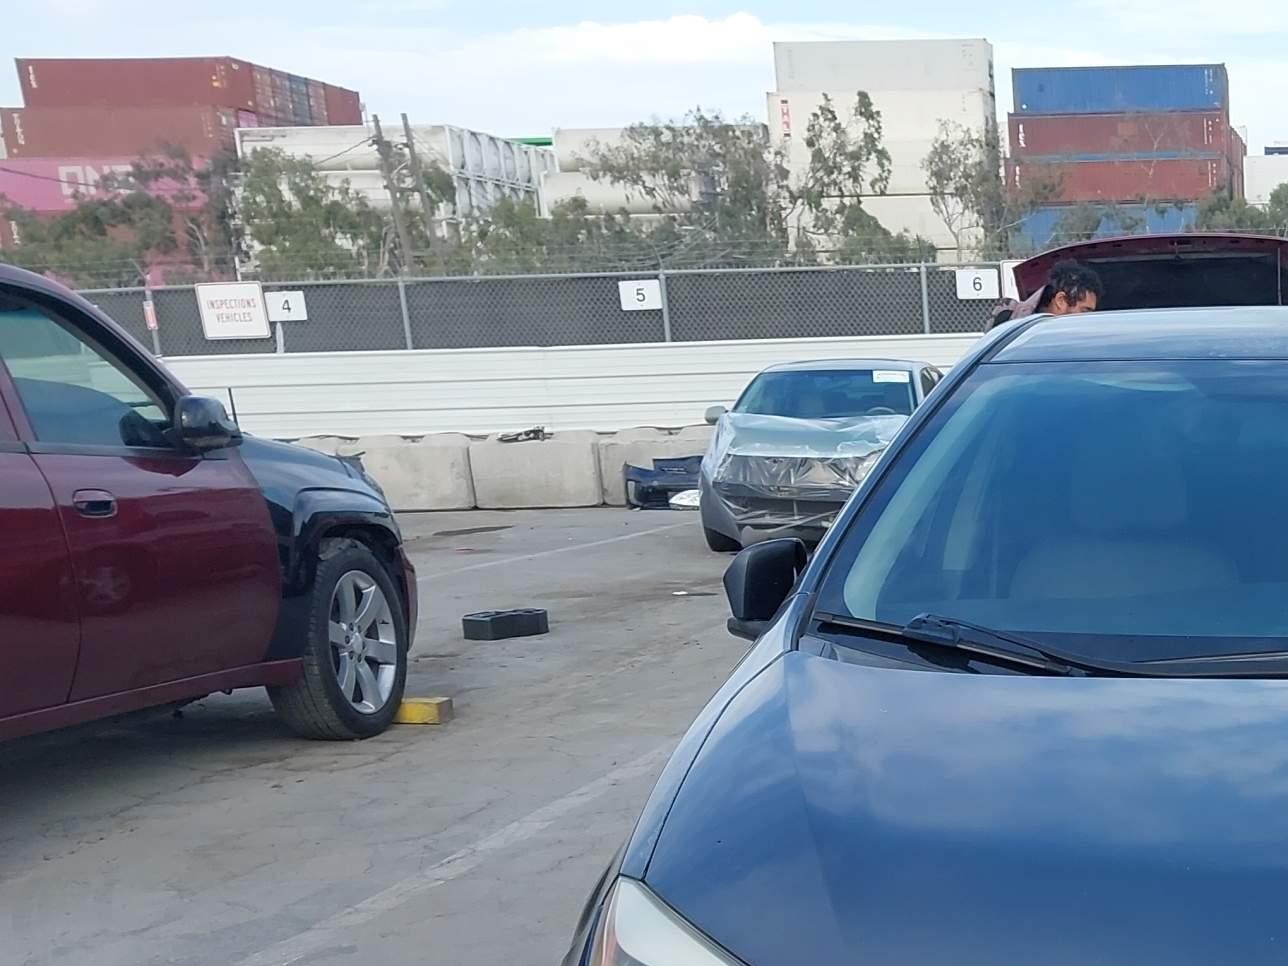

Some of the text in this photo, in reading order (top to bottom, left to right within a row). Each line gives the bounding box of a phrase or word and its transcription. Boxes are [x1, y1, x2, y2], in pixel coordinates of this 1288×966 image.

[972, 276, 983, 292] 6
[635, 287, 646, 303] 5
[207, 298, 257, 310] INSPECTIONS
[282, 299, 292, 313] 4
[216, 311, 253, 323] VEHICLES
